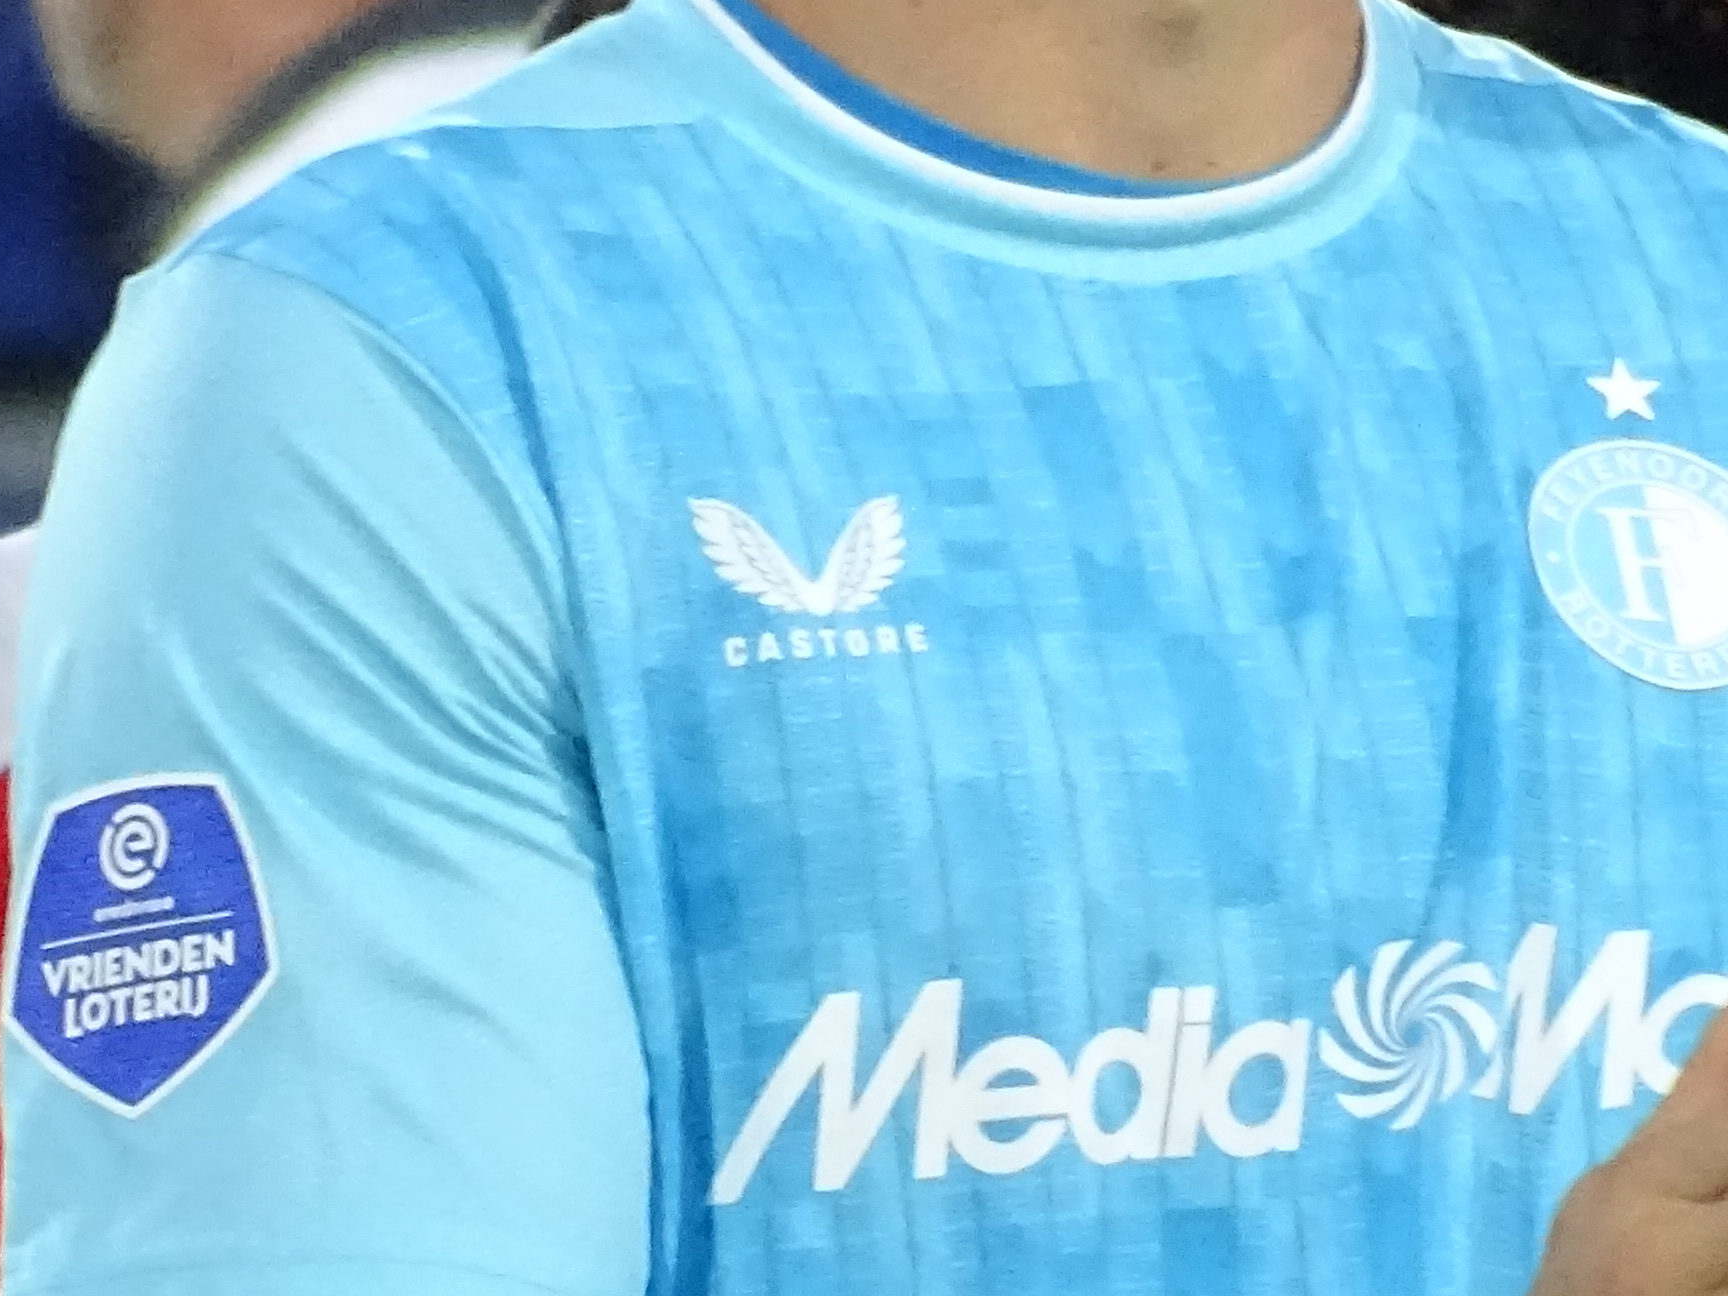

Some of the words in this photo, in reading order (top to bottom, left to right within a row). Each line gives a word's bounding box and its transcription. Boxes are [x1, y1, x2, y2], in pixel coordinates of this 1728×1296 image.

[724, 622, 928, 667] CASTORE
[41, 929, 235, 996] VRIENDEN
[64, 974, 209, 1039] LOTERIJ
[711, 978, 1312, 1204] Media
